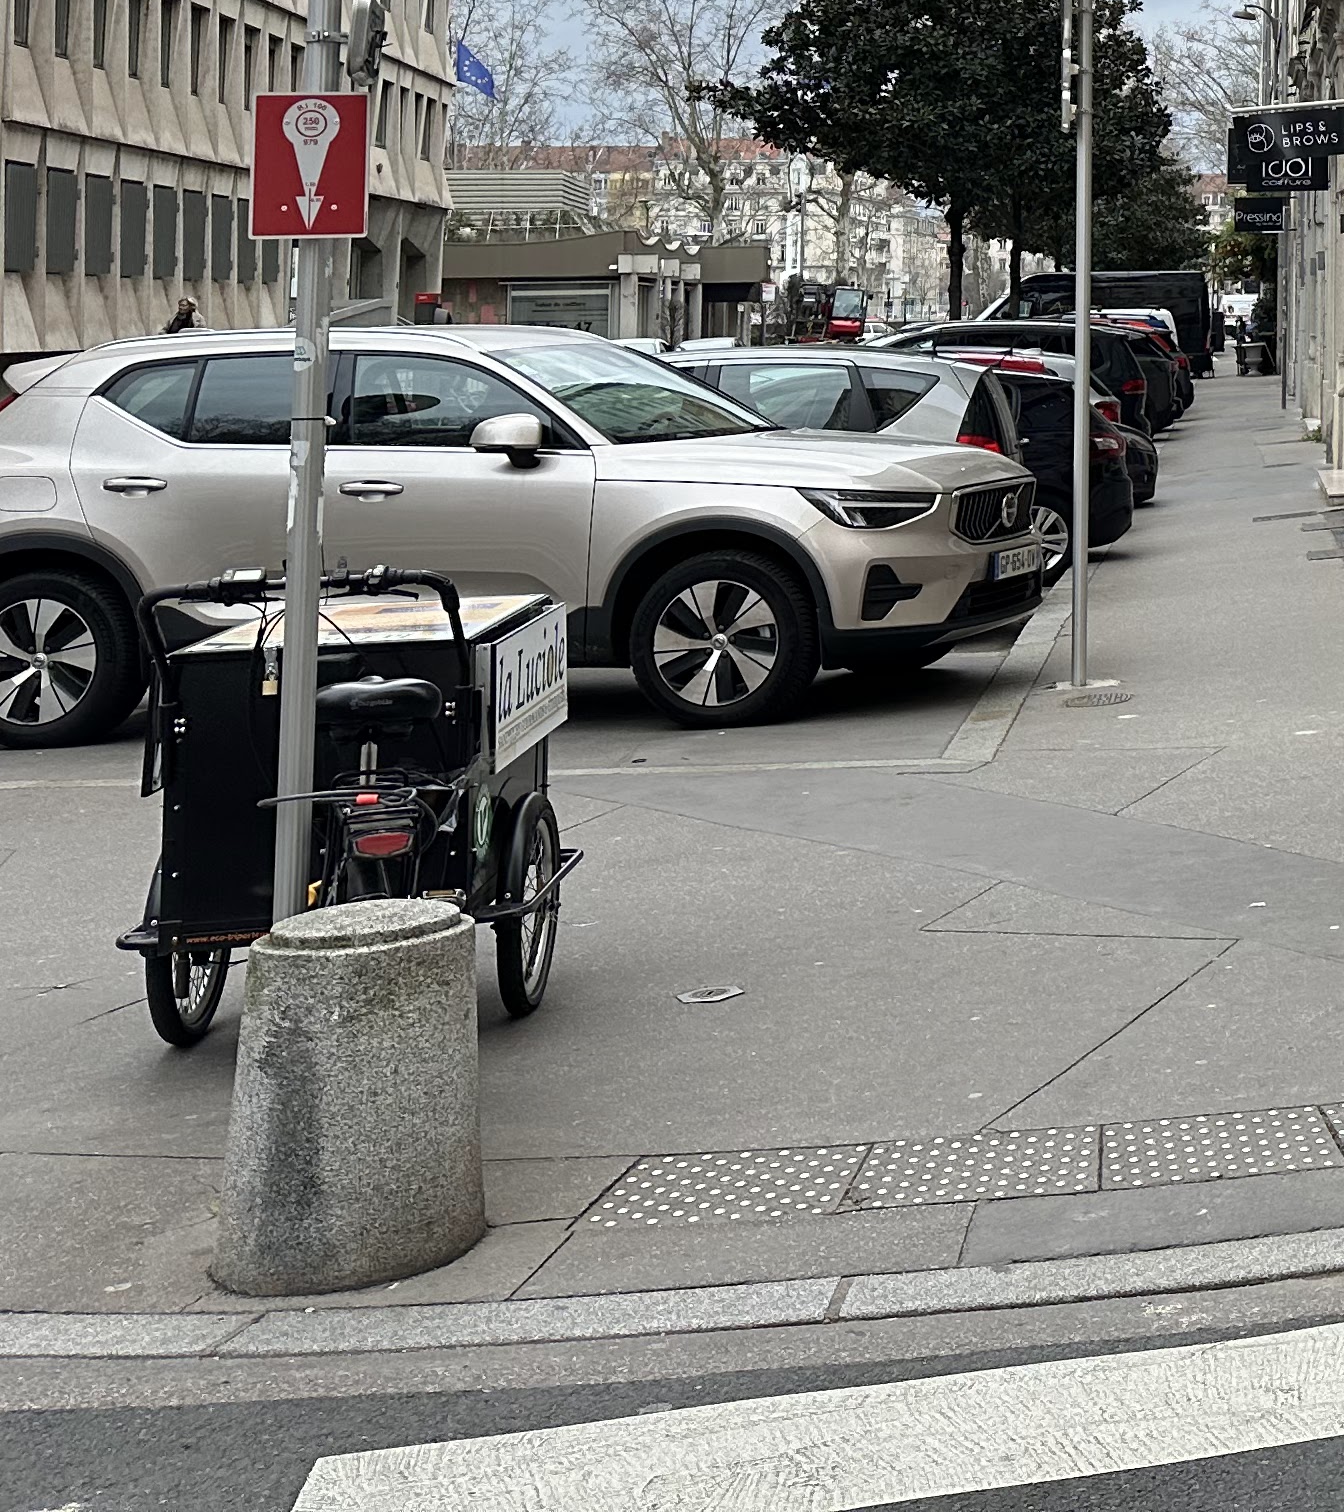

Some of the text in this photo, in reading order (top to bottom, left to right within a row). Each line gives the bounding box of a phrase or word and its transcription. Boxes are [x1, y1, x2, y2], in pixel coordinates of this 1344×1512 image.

[302, 117, 320, 125] 250
[1281, 121, 1326, 135] LIPS &
[1282, 133, 1339, 148] BROWS
[1262, 178, 1312, 186] coiffure
[1235, 211, 1282, 225] Pressing
[498, 655, 512, 724] la
[516, 621, 565, 711] Luciole
